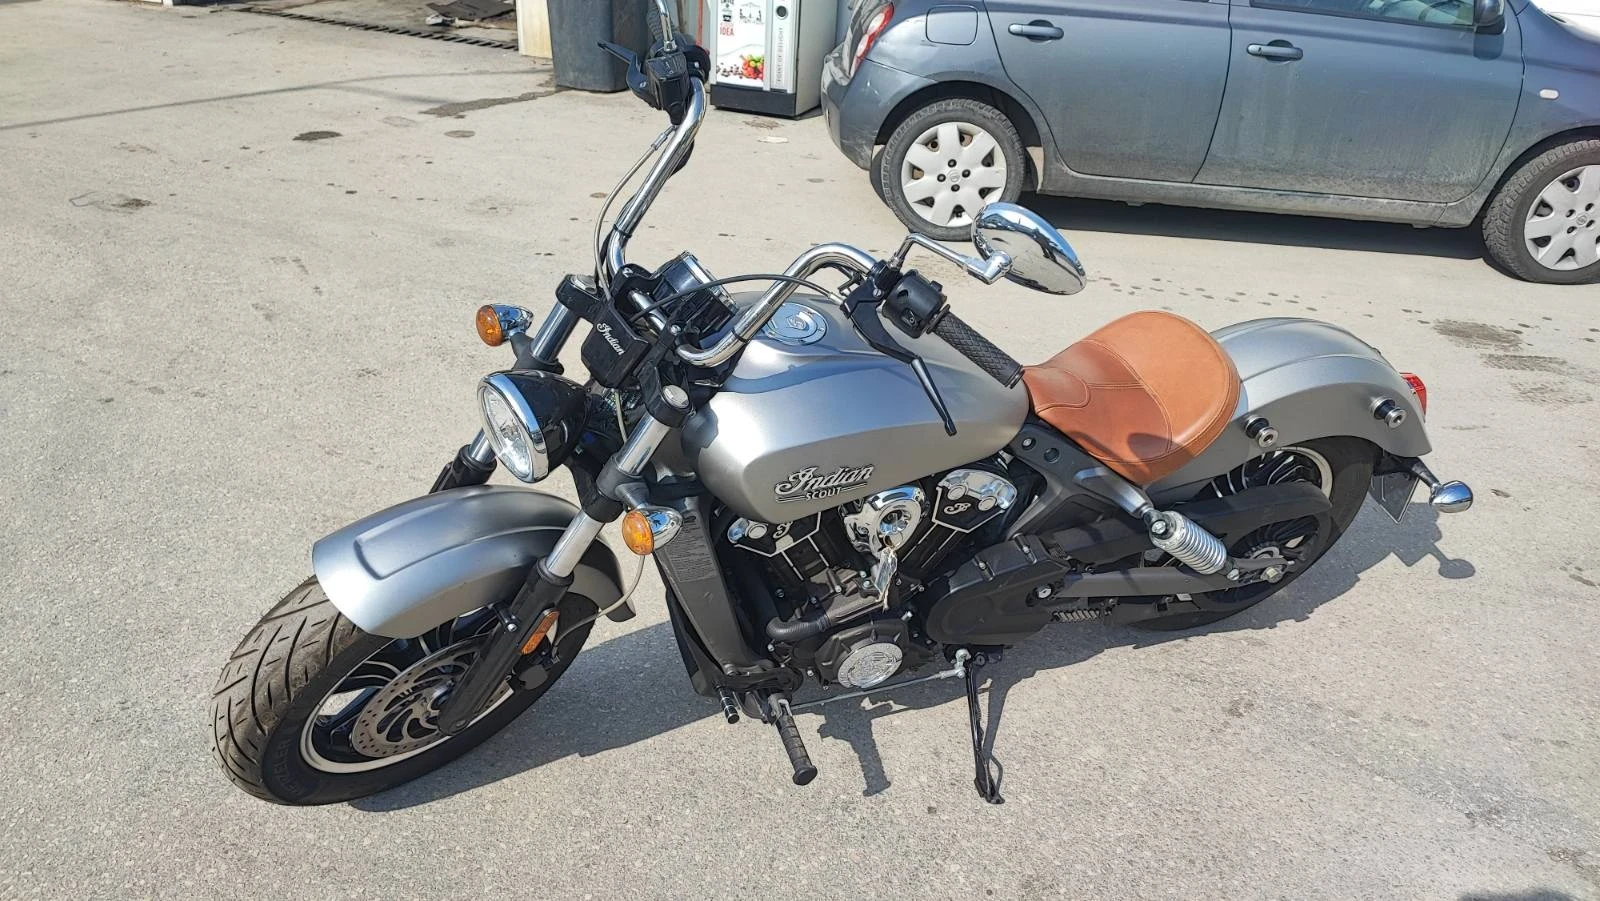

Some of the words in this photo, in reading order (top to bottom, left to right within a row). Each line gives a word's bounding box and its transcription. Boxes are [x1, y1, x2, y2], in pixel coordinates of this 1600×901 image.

[596, 323, 625, 355] Indian
[774, 464, 875, 495] Indian
[806, 487, 841, 501] SCOUT
